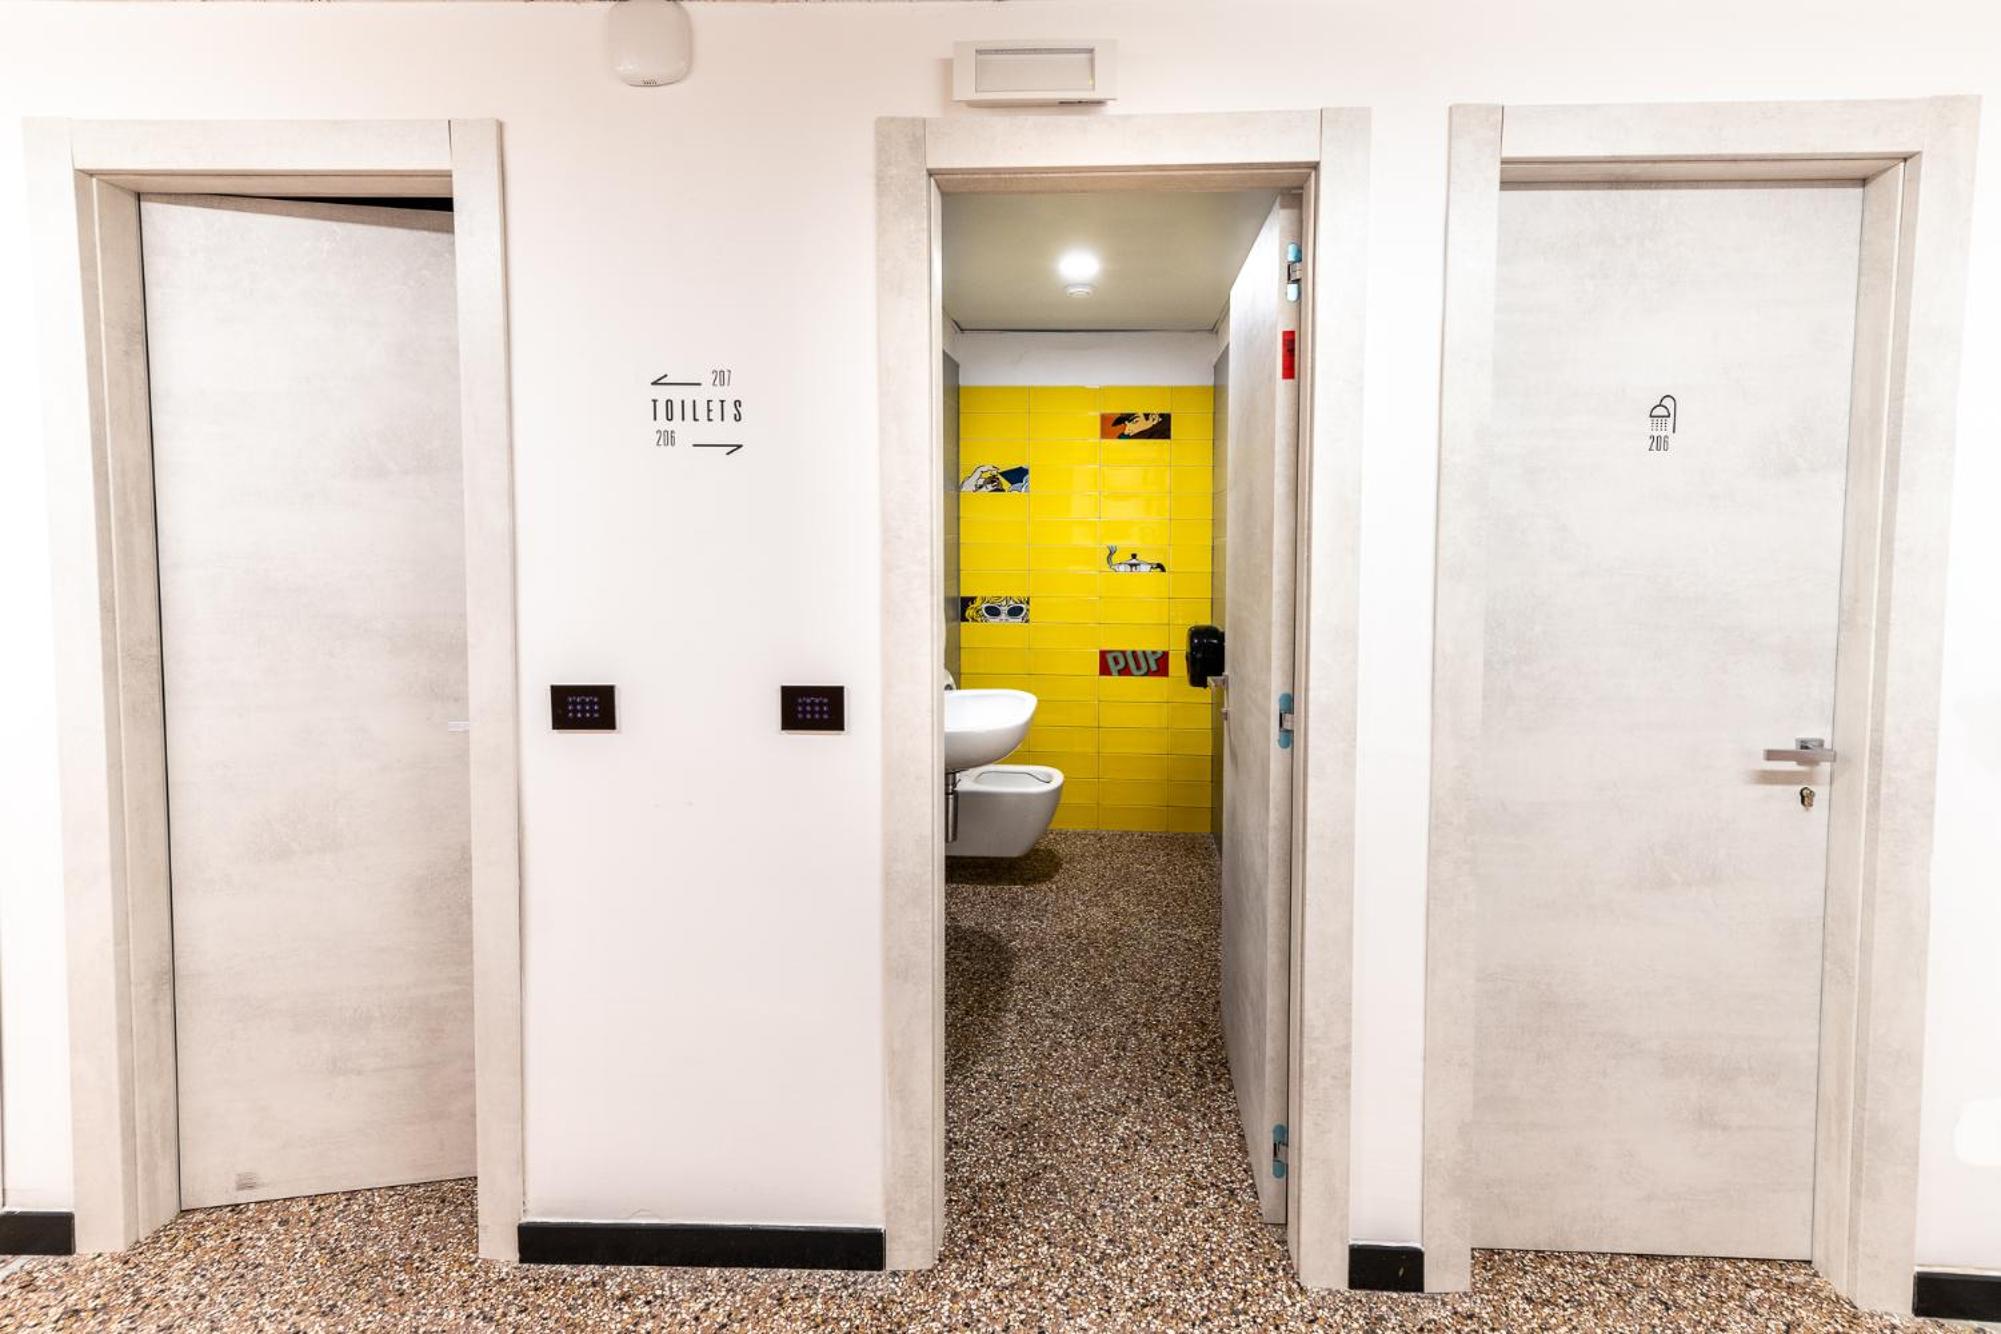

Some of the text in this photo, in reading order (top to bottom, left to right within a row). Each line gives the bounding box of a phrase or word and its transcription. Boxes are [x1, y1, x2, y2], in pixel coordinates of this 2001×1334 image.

[711, 369, 732, 387] 207
[651, 398, 742, 422] TOILETS
[656, 429, 676, 447] 206
[1648, 434, 1670, 452] 206
